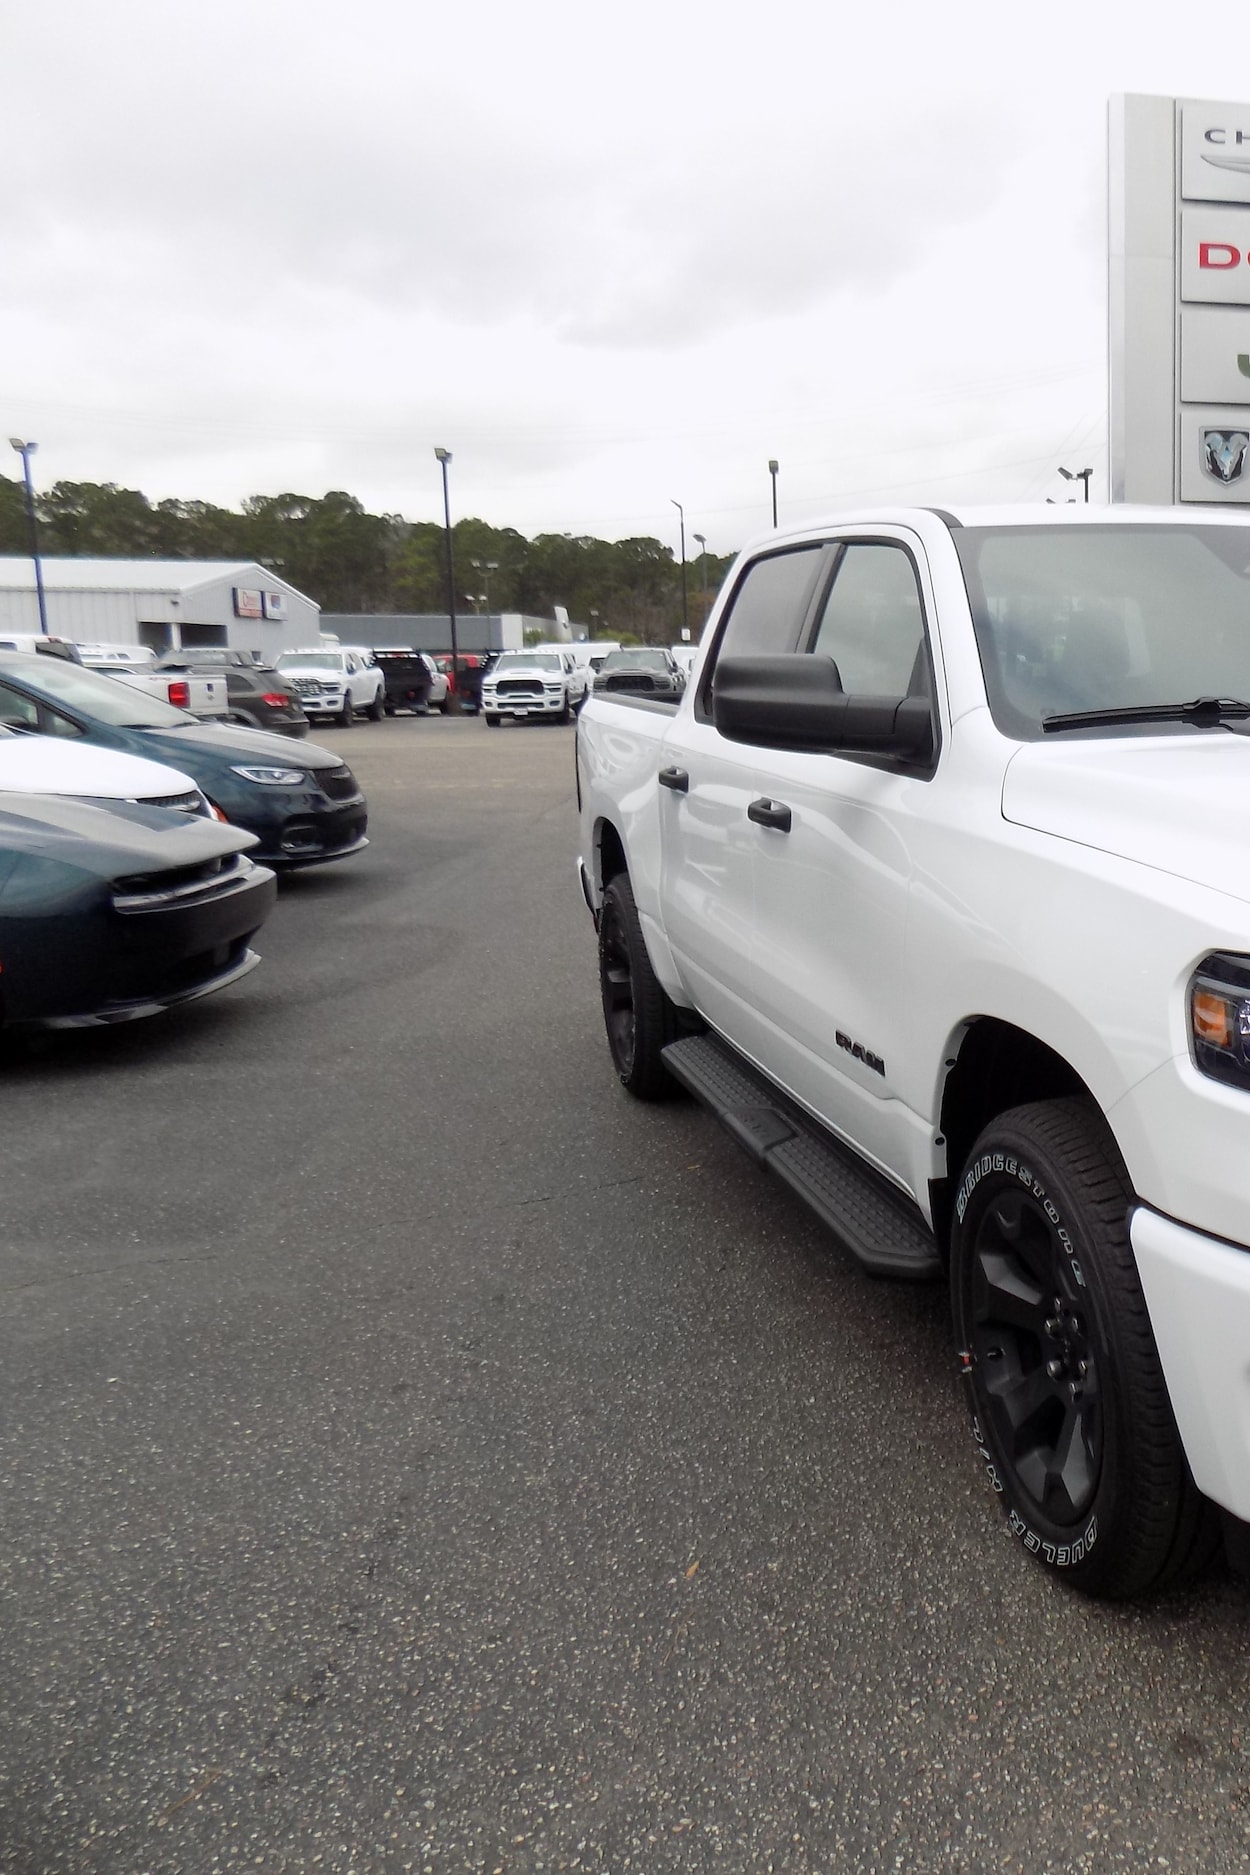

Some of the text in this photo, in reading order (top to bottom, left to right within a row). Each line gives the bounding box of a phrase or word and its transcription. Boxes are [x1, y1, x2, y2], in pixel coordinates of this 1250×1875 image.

[835, 1028, 886, 1077] RAM
[956, 1153, 1087, 1288] BRIDGESTONE
[1009, 1509, 1098, 1566] DUELER
